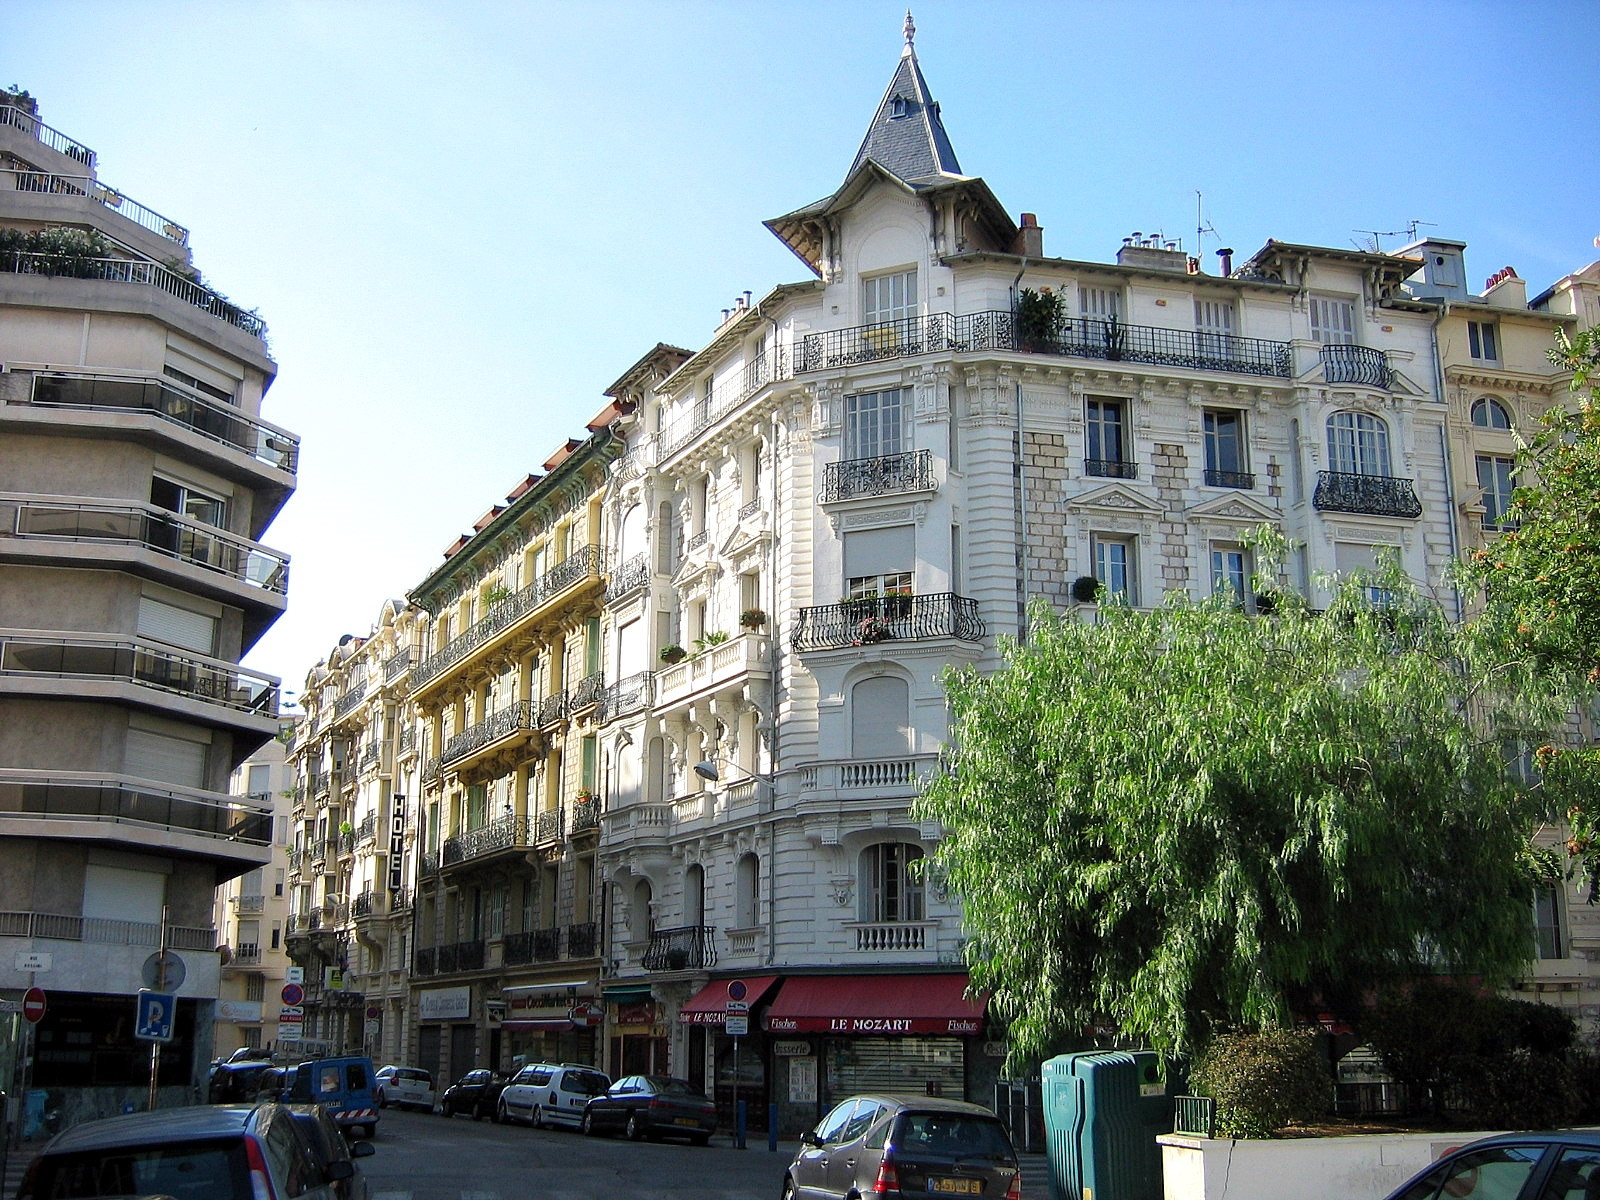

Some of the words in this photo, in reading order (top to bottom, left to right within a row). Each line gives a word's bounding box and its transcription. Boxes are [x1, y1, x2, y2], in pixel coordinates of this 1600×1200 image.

[389, 798, 404, 889] HOTEL
[147, 1000, 164, 1029] P
[693, 1012, 702, 1022] LE
[702, 1012, 727, 1023] MOZAR
[771, 1018, 798, 1030] Fischer
[830, 1019, 847, 1030] LE
[852, 1019, 912, 1031] MOZART
[947, 1019, 978, 1031] Fischer
